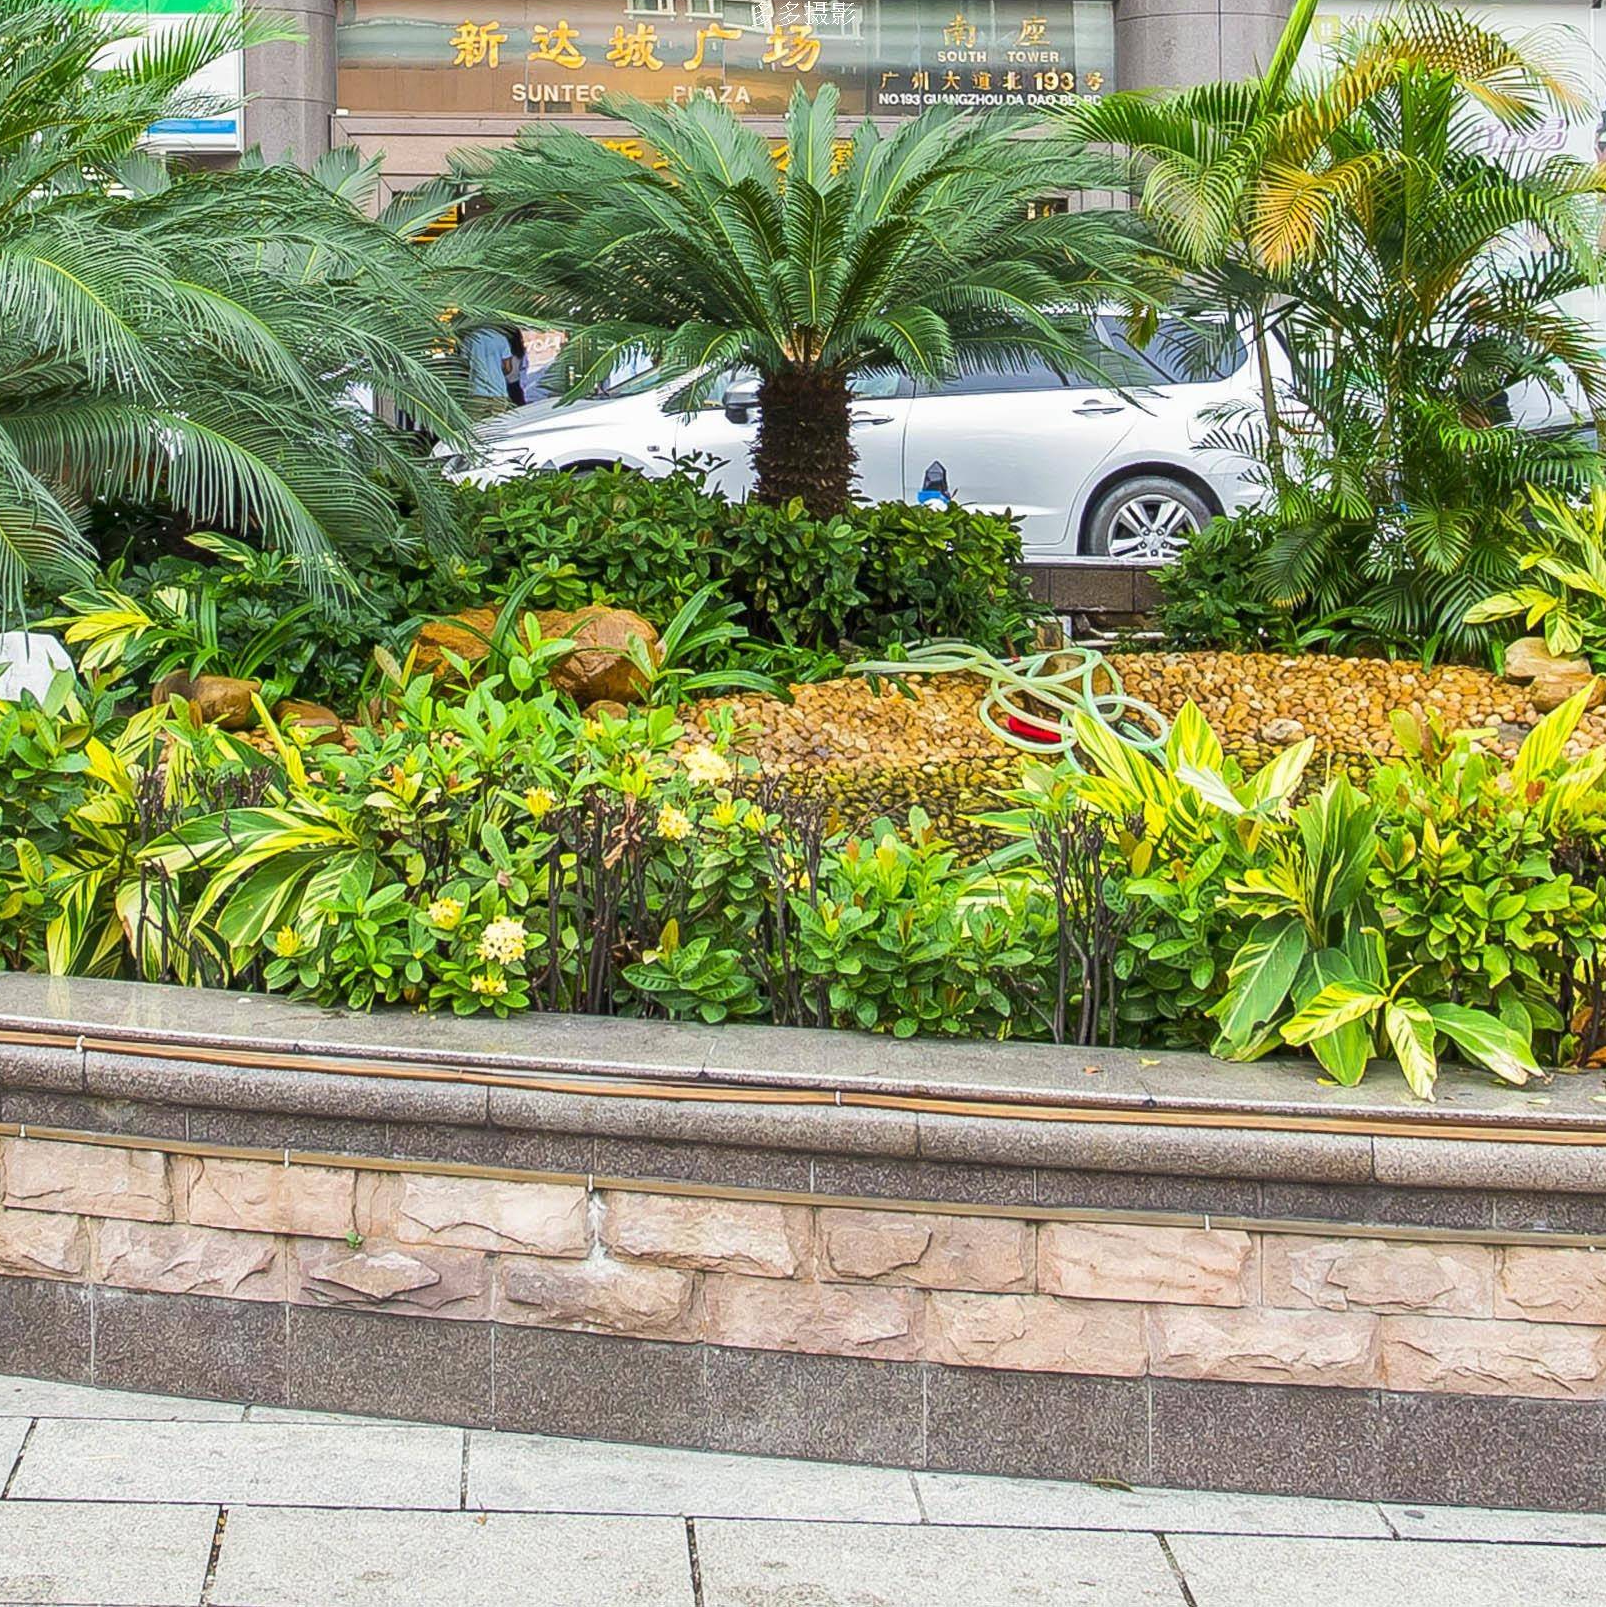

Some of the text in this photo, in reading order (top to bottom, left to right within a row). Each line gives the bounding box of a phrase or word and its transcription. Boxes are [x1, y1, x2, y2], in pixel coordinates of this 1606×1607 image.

[943, 13, 1051, 47] 南座
[449, 20, 822, 72] 新达城广场
[938, 50, 1059, 63] SOUTH TOWER
[512, 83, 606, 102] SUNTEC
[924, 93, 1002, 106] GUANGZHOU
[1006, 93, 1024, 106] DA
